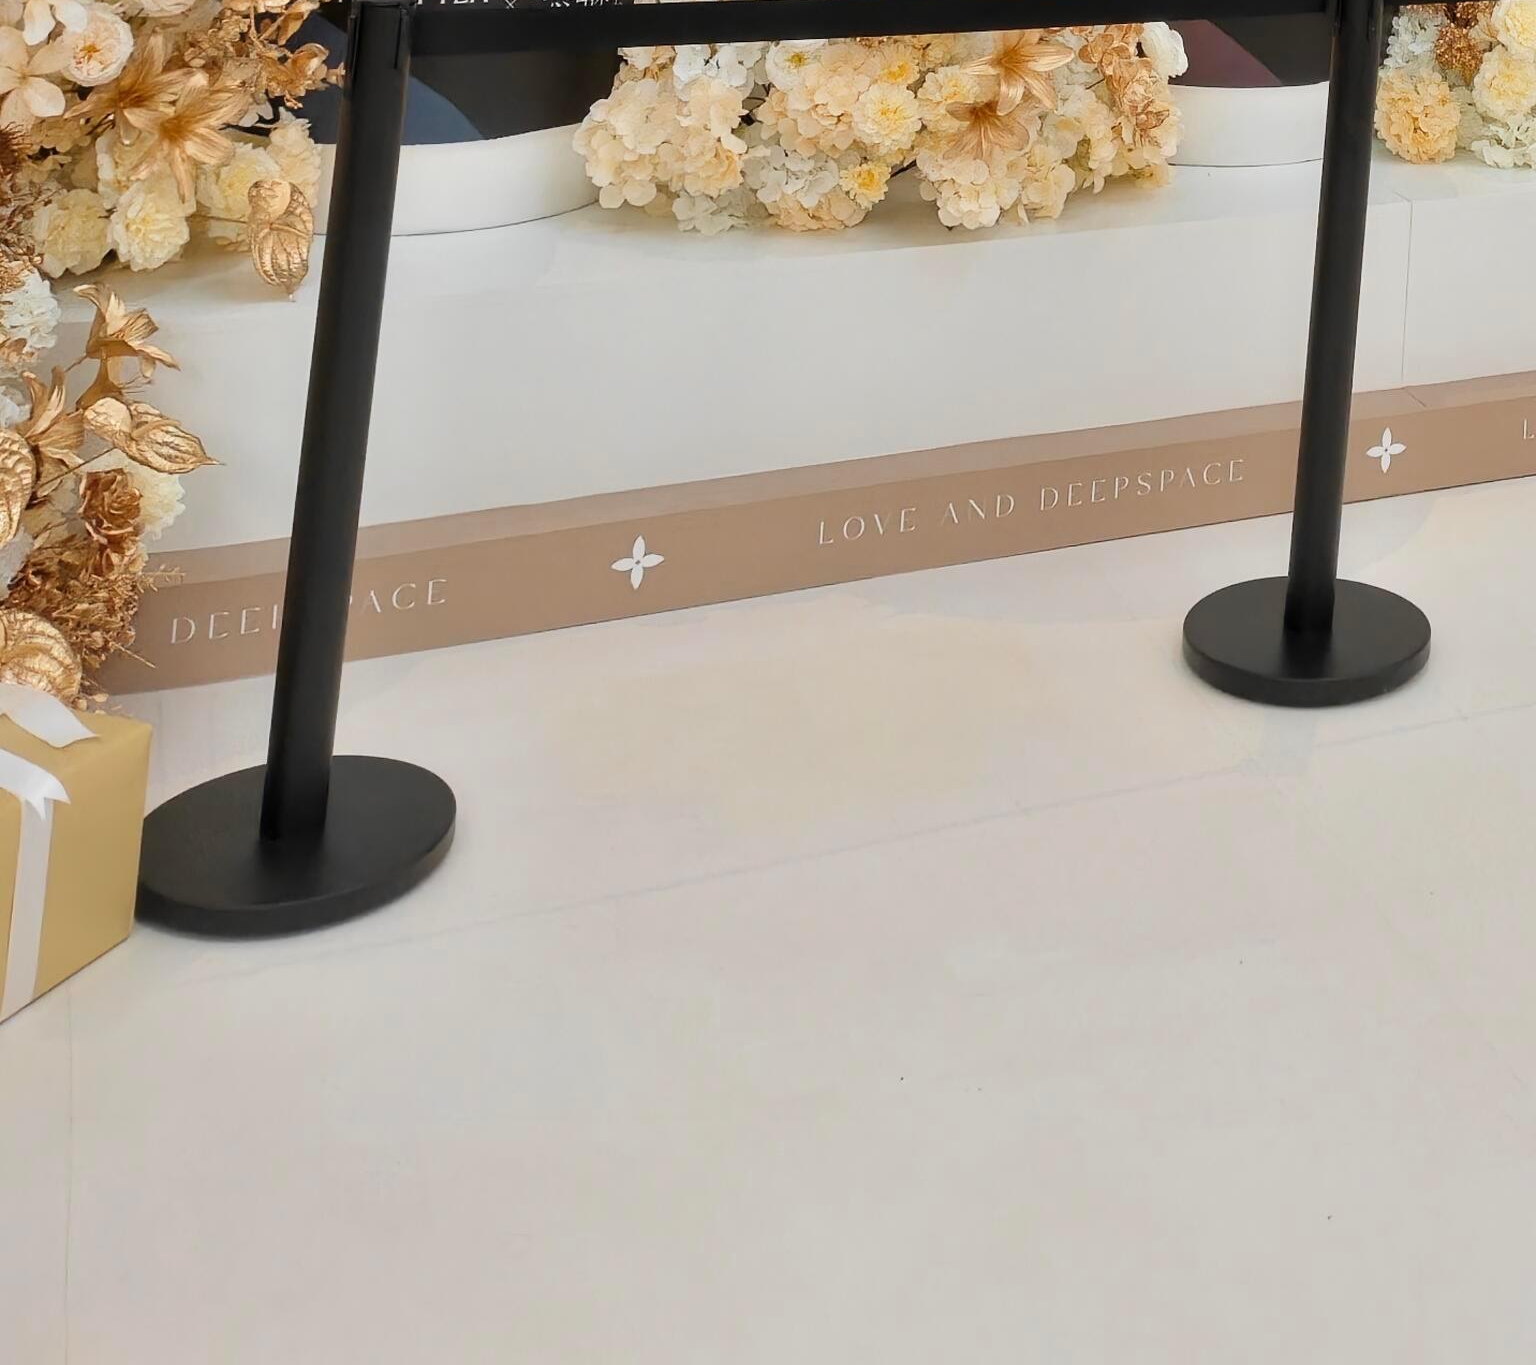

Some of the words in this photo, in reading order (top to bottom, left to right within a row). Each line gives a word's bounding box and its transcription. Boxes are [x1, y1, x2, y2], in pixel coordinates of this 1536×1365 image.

[817, 507, 918, 545] LOVE
[943, 493, 1016, 528] AND
[1039, 458, 1246, 511] DEEPSPACE
[171, 578, 449, 646] DEEACE
